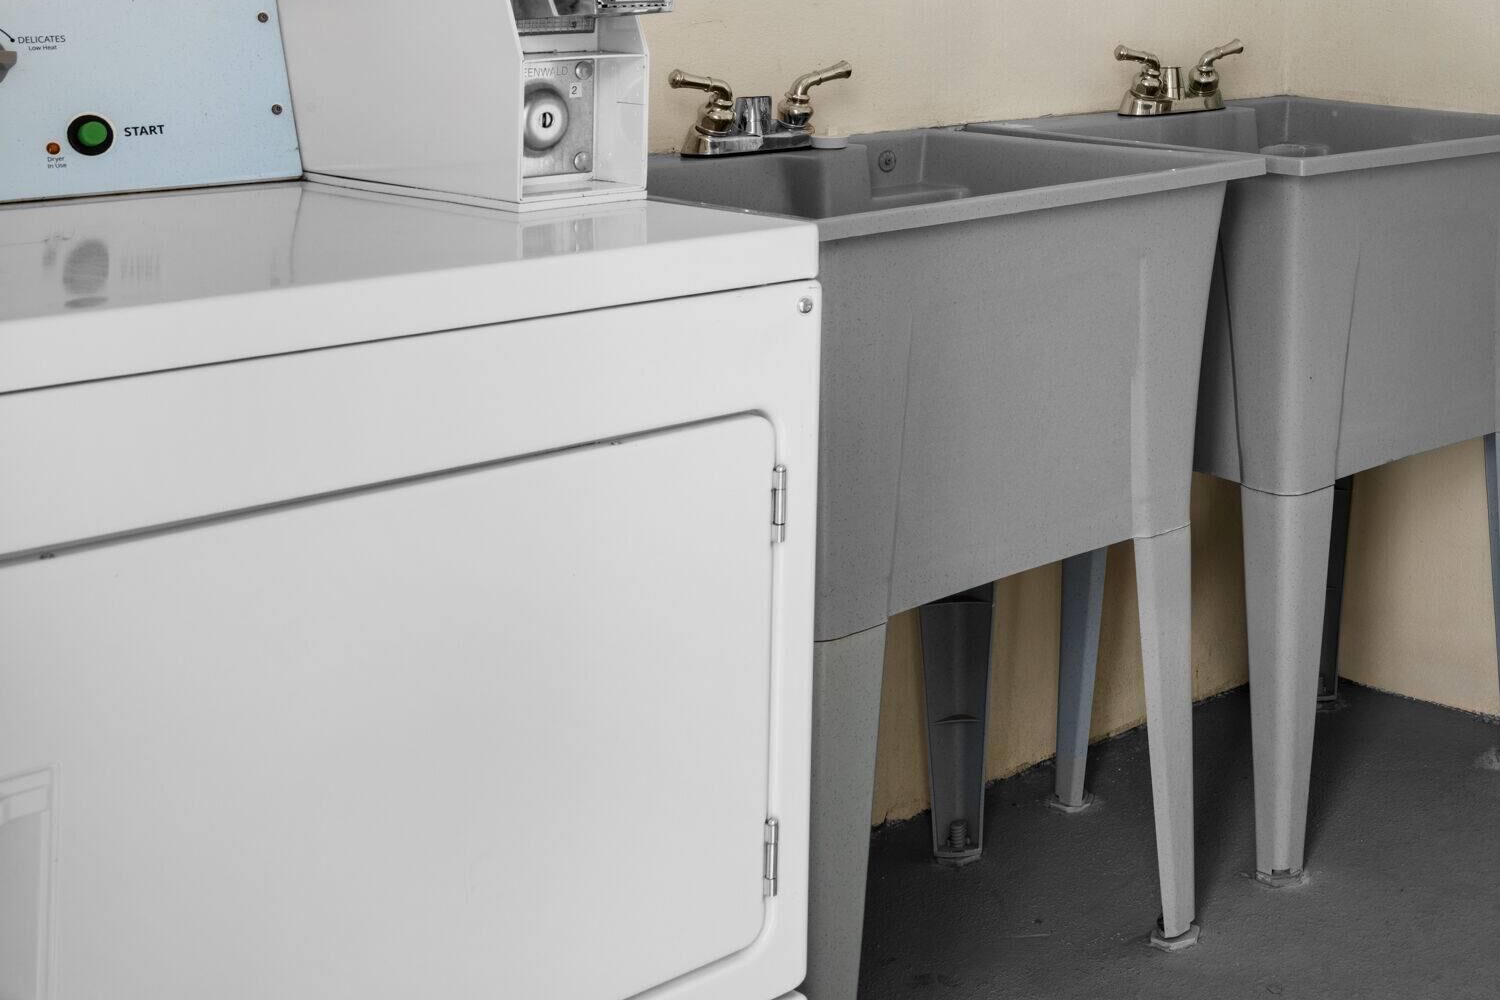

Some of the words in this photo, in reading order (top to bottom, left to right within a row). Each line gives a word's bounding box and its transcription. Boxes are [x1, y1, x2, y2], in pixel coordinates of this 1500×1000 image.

[17, 35, 66, 44] DELICATES
[571, 85, 578, 95] 2
[124, 124, 165, 137] START
